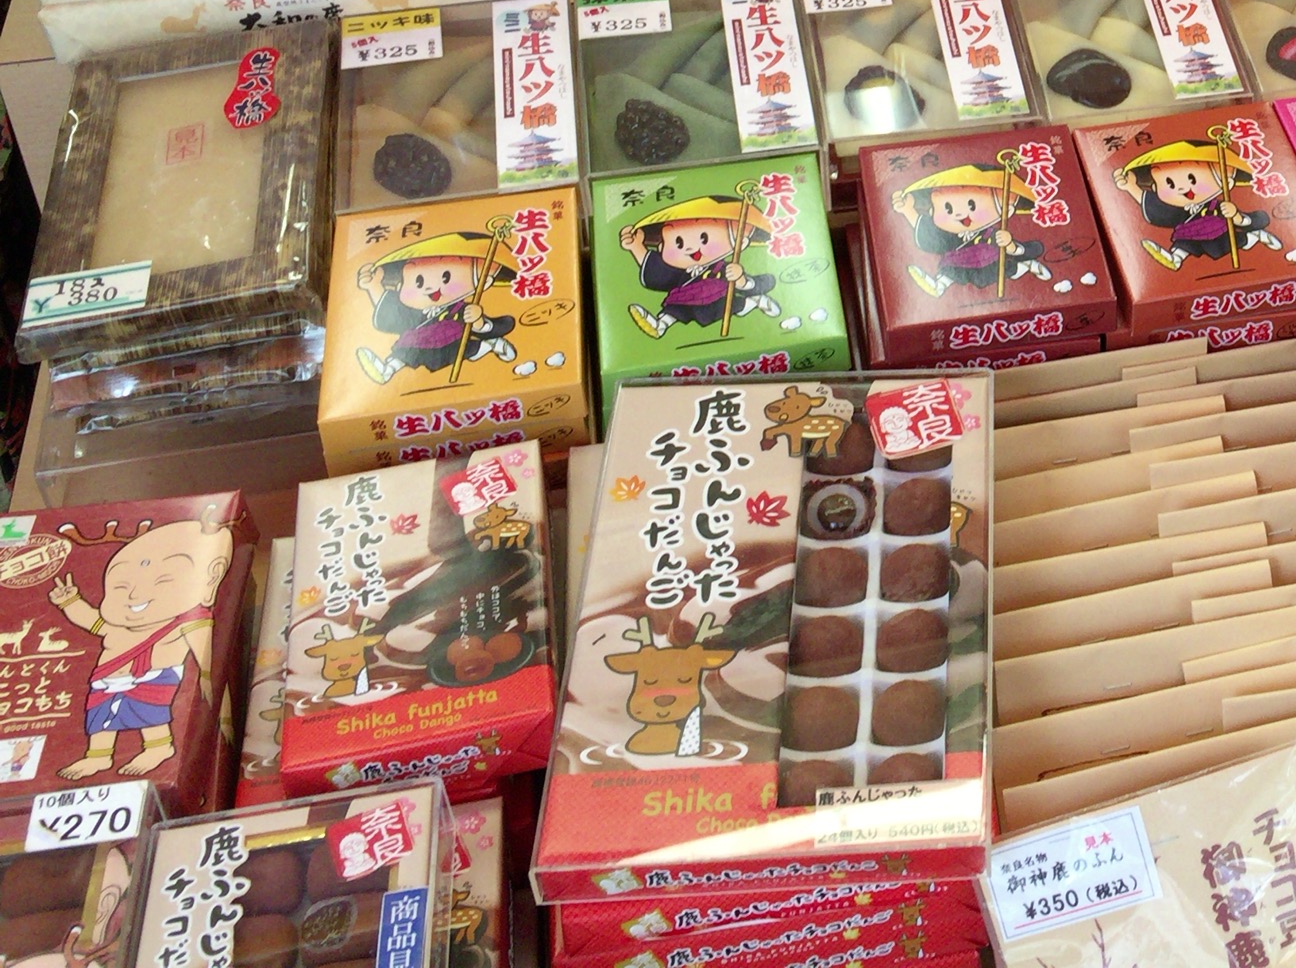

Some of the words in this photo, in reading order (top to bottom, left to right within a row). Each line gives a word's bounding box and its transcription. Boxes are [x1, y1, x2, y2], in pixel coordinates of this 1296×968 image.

[347, 12, 434, 33] ニッキ味
[591, 17, 647, 33] ¥325
[358, 44, 418, 62] ¥325
[694, 390, 753, 604] 鹿ふんじゃった
[645, 433, 693, 608] チョコだんご
[345, 475, 388, 608] 鹿ふんじゃった
[317, 507, 353, 615] チョコだんご
[336, 713, 396, 736] Shika
[407, 688, 498, 719] funjatta
[373, 724, 413, 740] Choco
[419, 712, 462, 731] Dango
[38, 787, 110, 808] 10個入り
[642, 788, 733, 817] Shika
[819, 784, 923, 808] 鹿ふんじゃった
[1084, 833, 1115, 848] 見本
[1001, 852, 1048, 874] 奈良名物
[1023, 888, 1081, 919] ¥350
